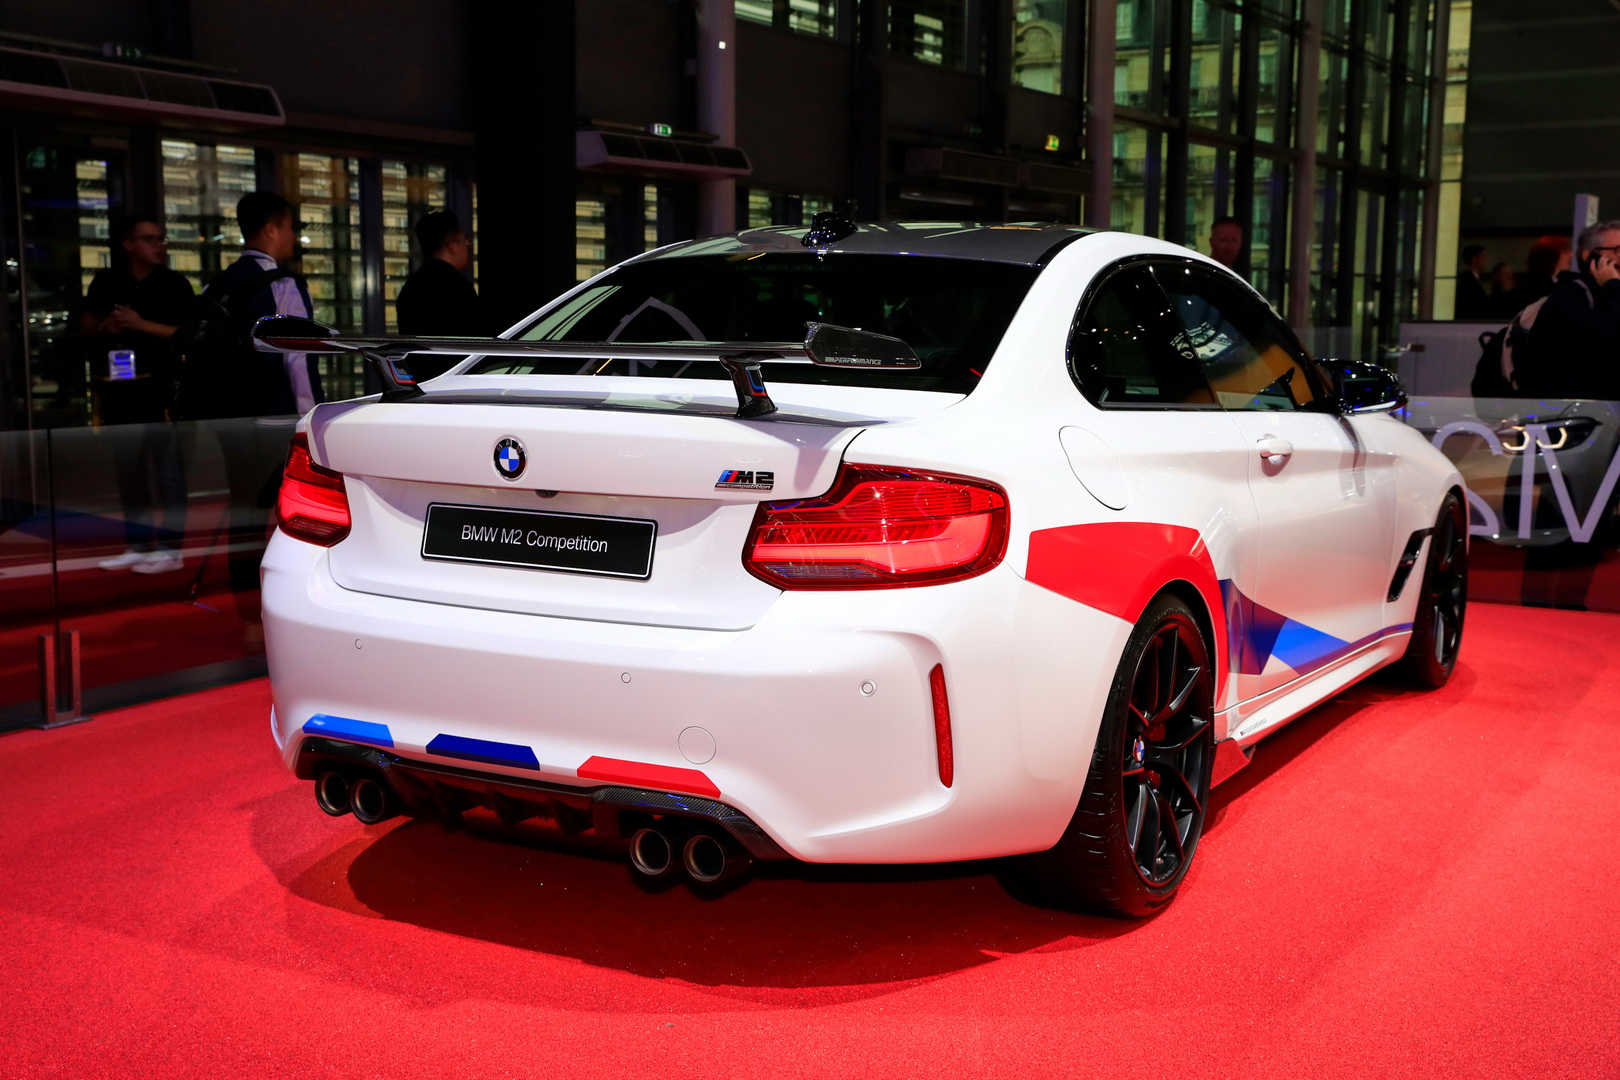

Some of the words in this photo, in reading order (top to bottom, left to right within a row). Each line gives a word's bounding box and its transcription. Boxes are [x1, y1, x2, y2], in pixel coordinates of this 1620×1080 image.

[461, 524, 499, 543] BMW
[500, 527, 523, 545] M2
[526, 530, 608, 553] Competition
